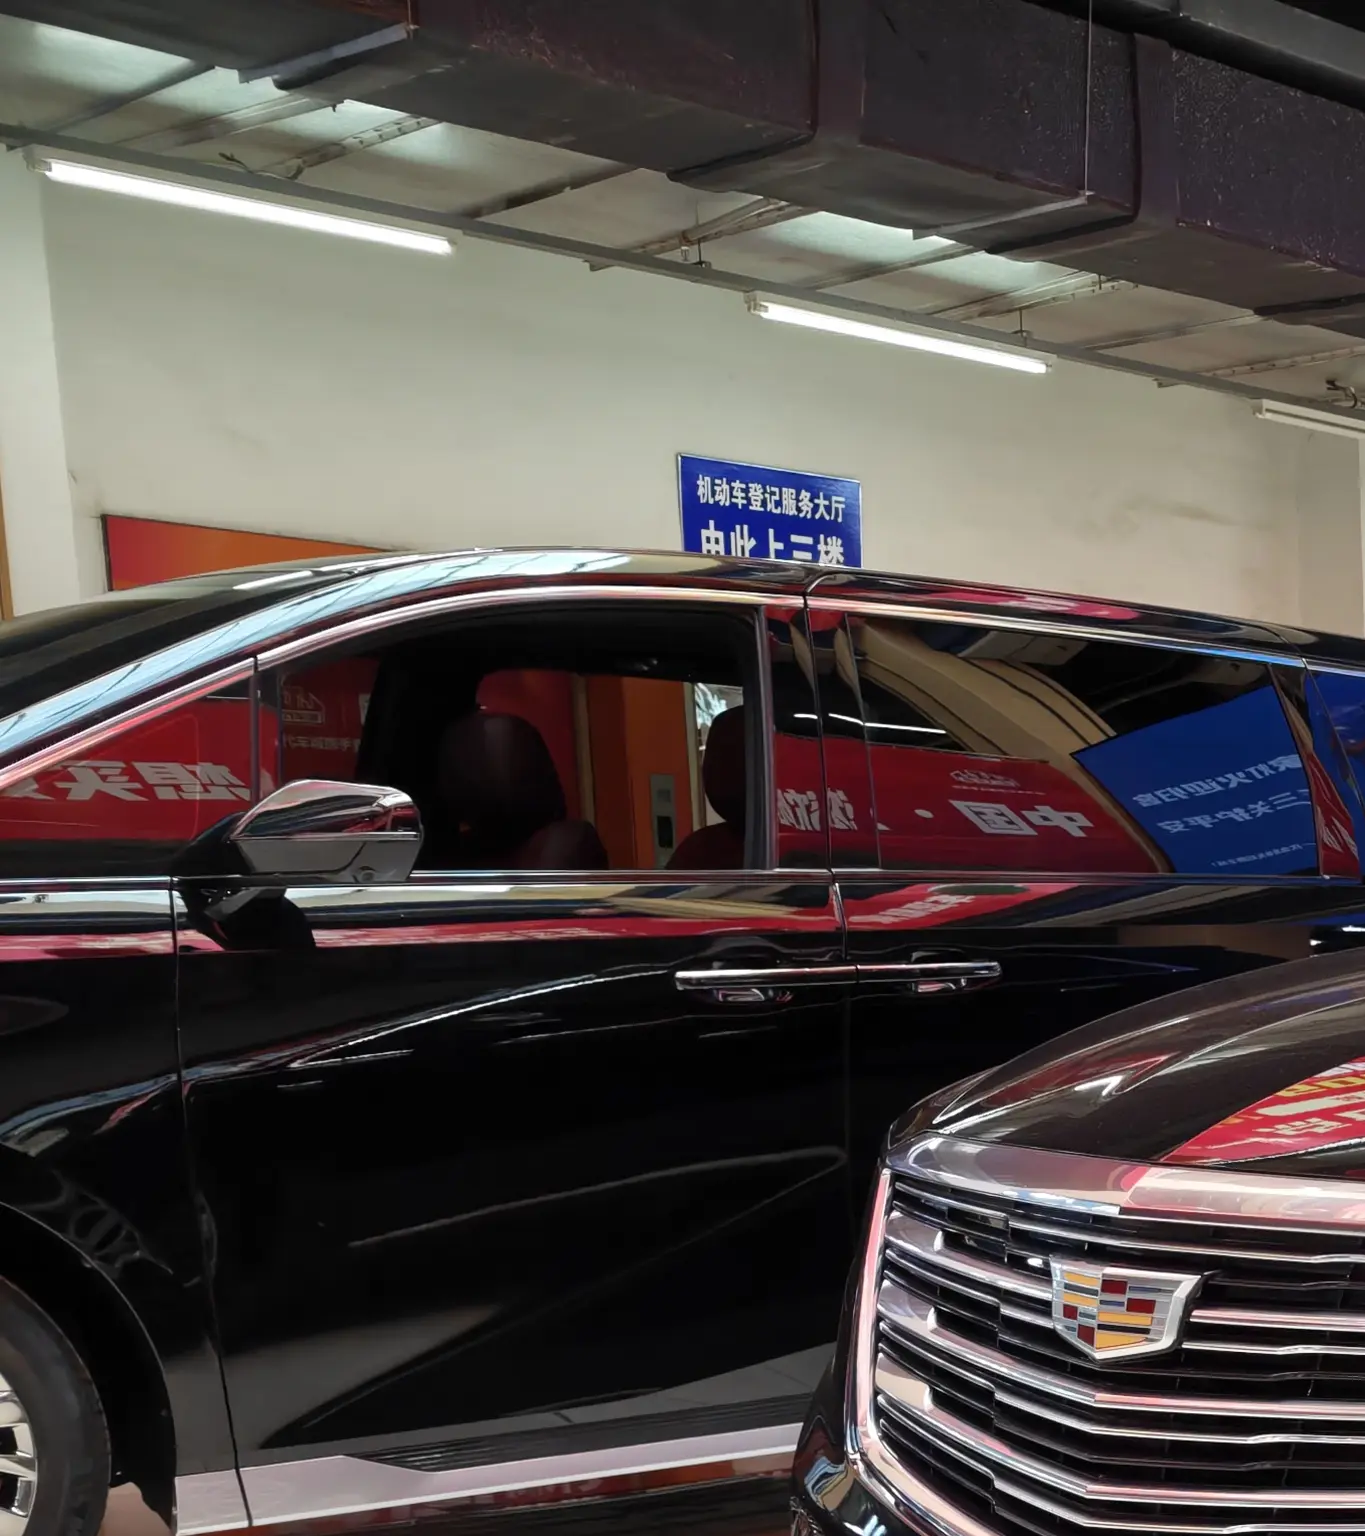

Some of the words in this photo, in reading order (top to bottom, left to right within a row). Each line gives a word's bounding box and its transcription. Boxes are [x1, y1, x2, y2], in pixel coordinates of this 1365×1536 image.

[697, 474, 846, 523] 机动车登记服务大厅
